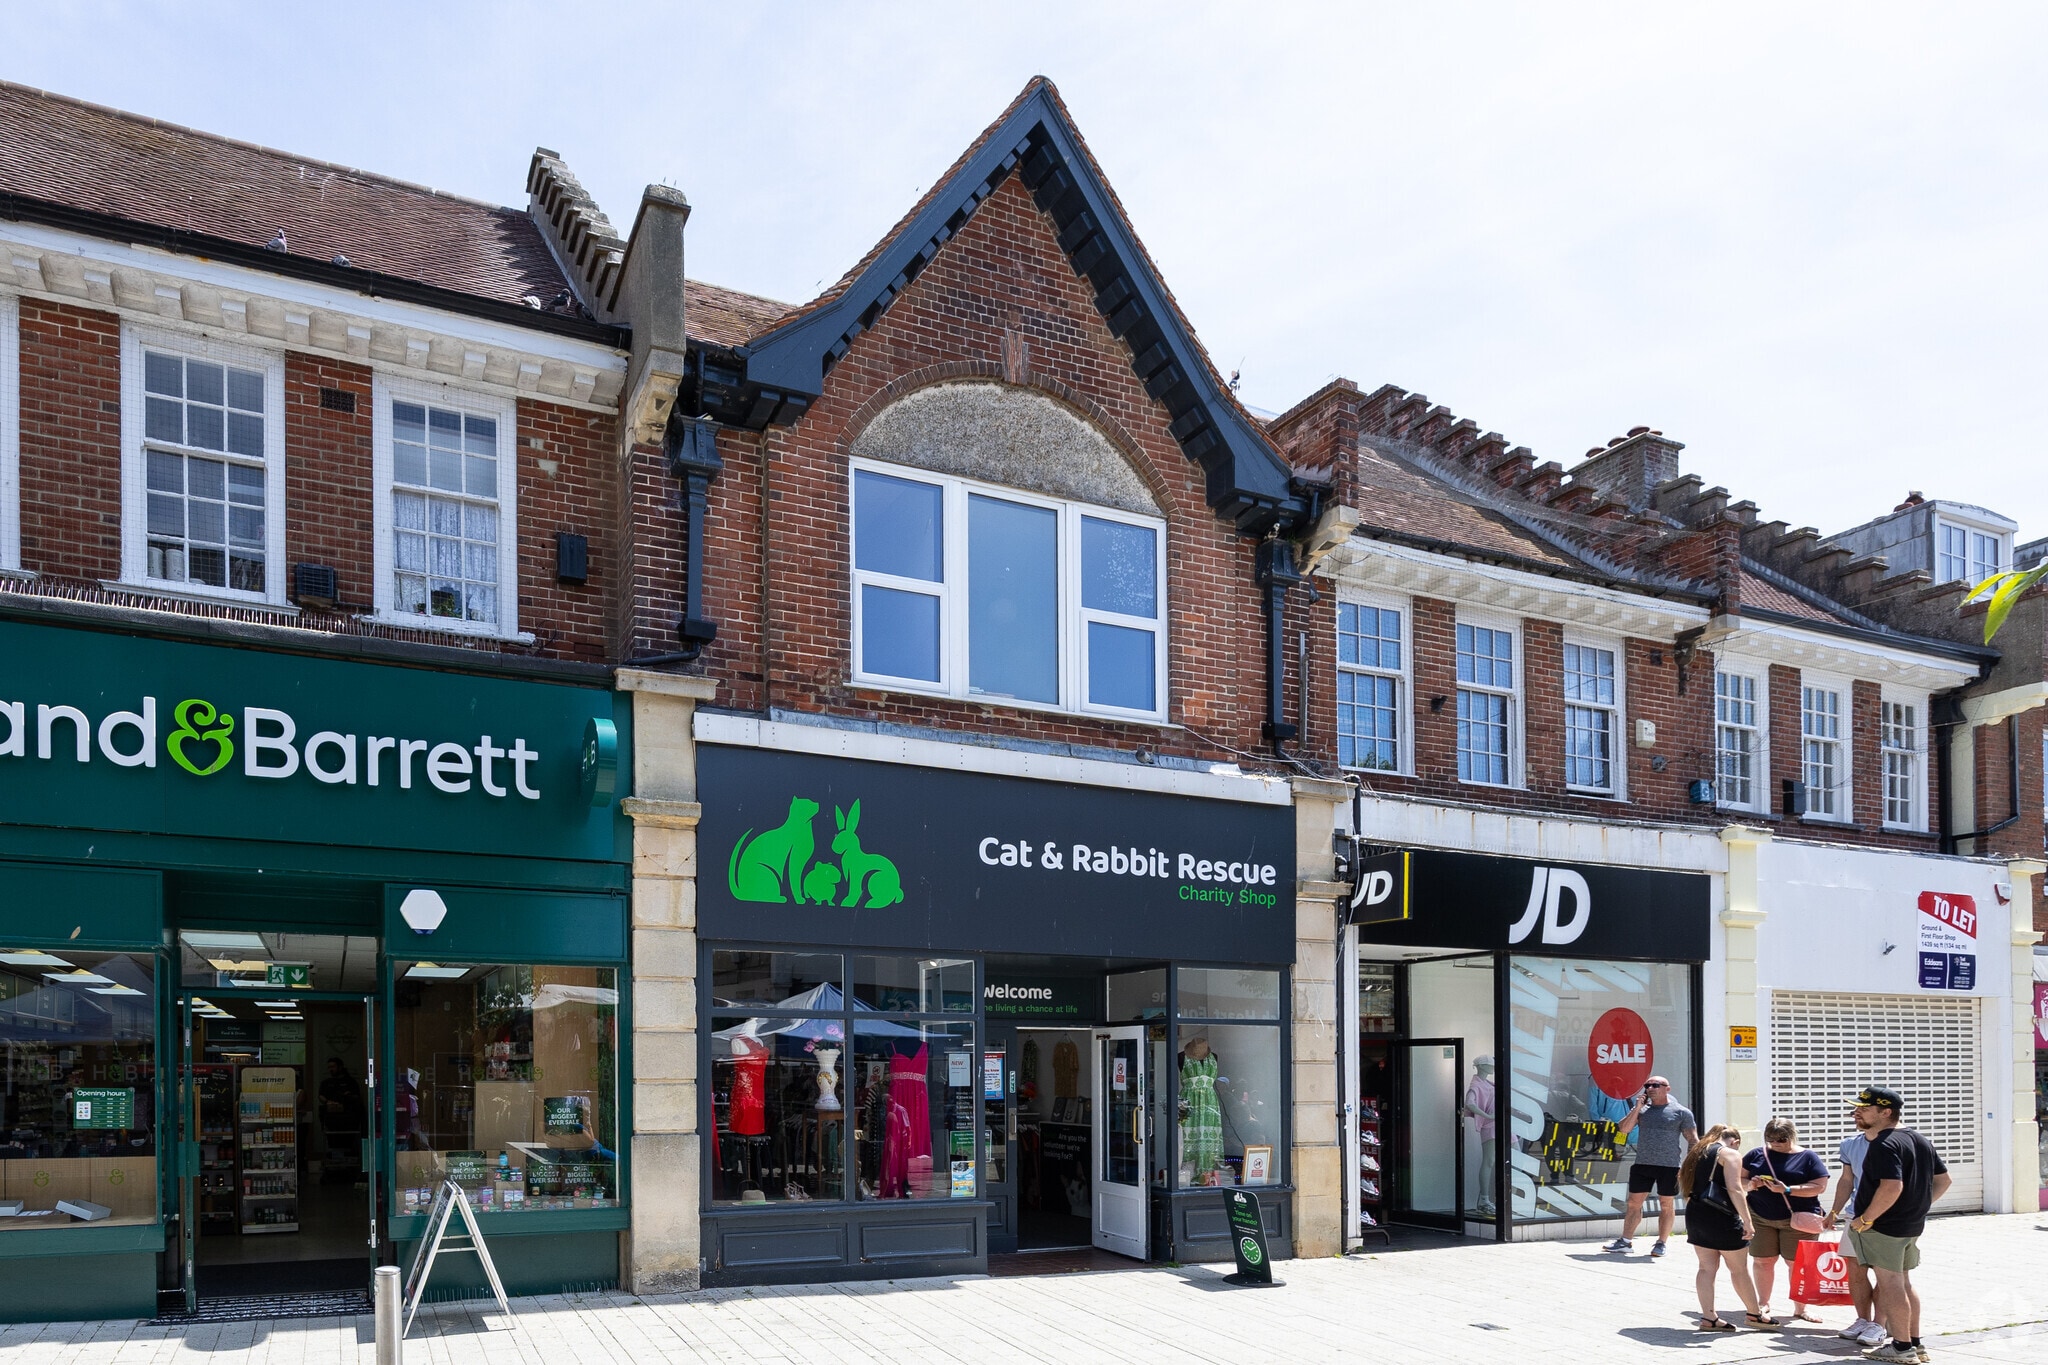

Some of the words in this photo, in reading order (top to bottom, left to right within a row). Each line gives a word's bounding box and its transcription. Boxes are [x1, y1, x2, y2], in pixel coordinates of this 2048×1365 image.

[244, 706, 540, 800] Barrett
[978, 836, 1033, 868] Cat
[1040, 841, 1064, 870] &
[1072, 844, 1170, 879] Rabbit
[1178, 853, 1277, 886] Rescue
[1179, 885, 1234, 907] Charity
[1239, 889, 1277, 908] Shop
[1350, 870, 1393, 909] JD
[1508, 866, 1592, 945] JD
[1933, 894, 1951, 920] TO
[1951, 905, 1976, 933] LET
[984, 983, 1052, 1001] Welcome
[995, 1003, 1017, 1014] living
[1025, 1004, 1054, 1013] chance
[1056, 1005, 1064, 1013] at
[1065, 1005, 1078, 1014] life
[1596, 1043, 1646, 1064] SALE
[76, 1089, 106, 1098] Opening
[1067, 1135, 1077, 1143] you
[1077, 1134, 1087, 1143] the
[1822, 1258, 1843, 1273] JD
[1819, 1280, 1849, 1289] SALE
